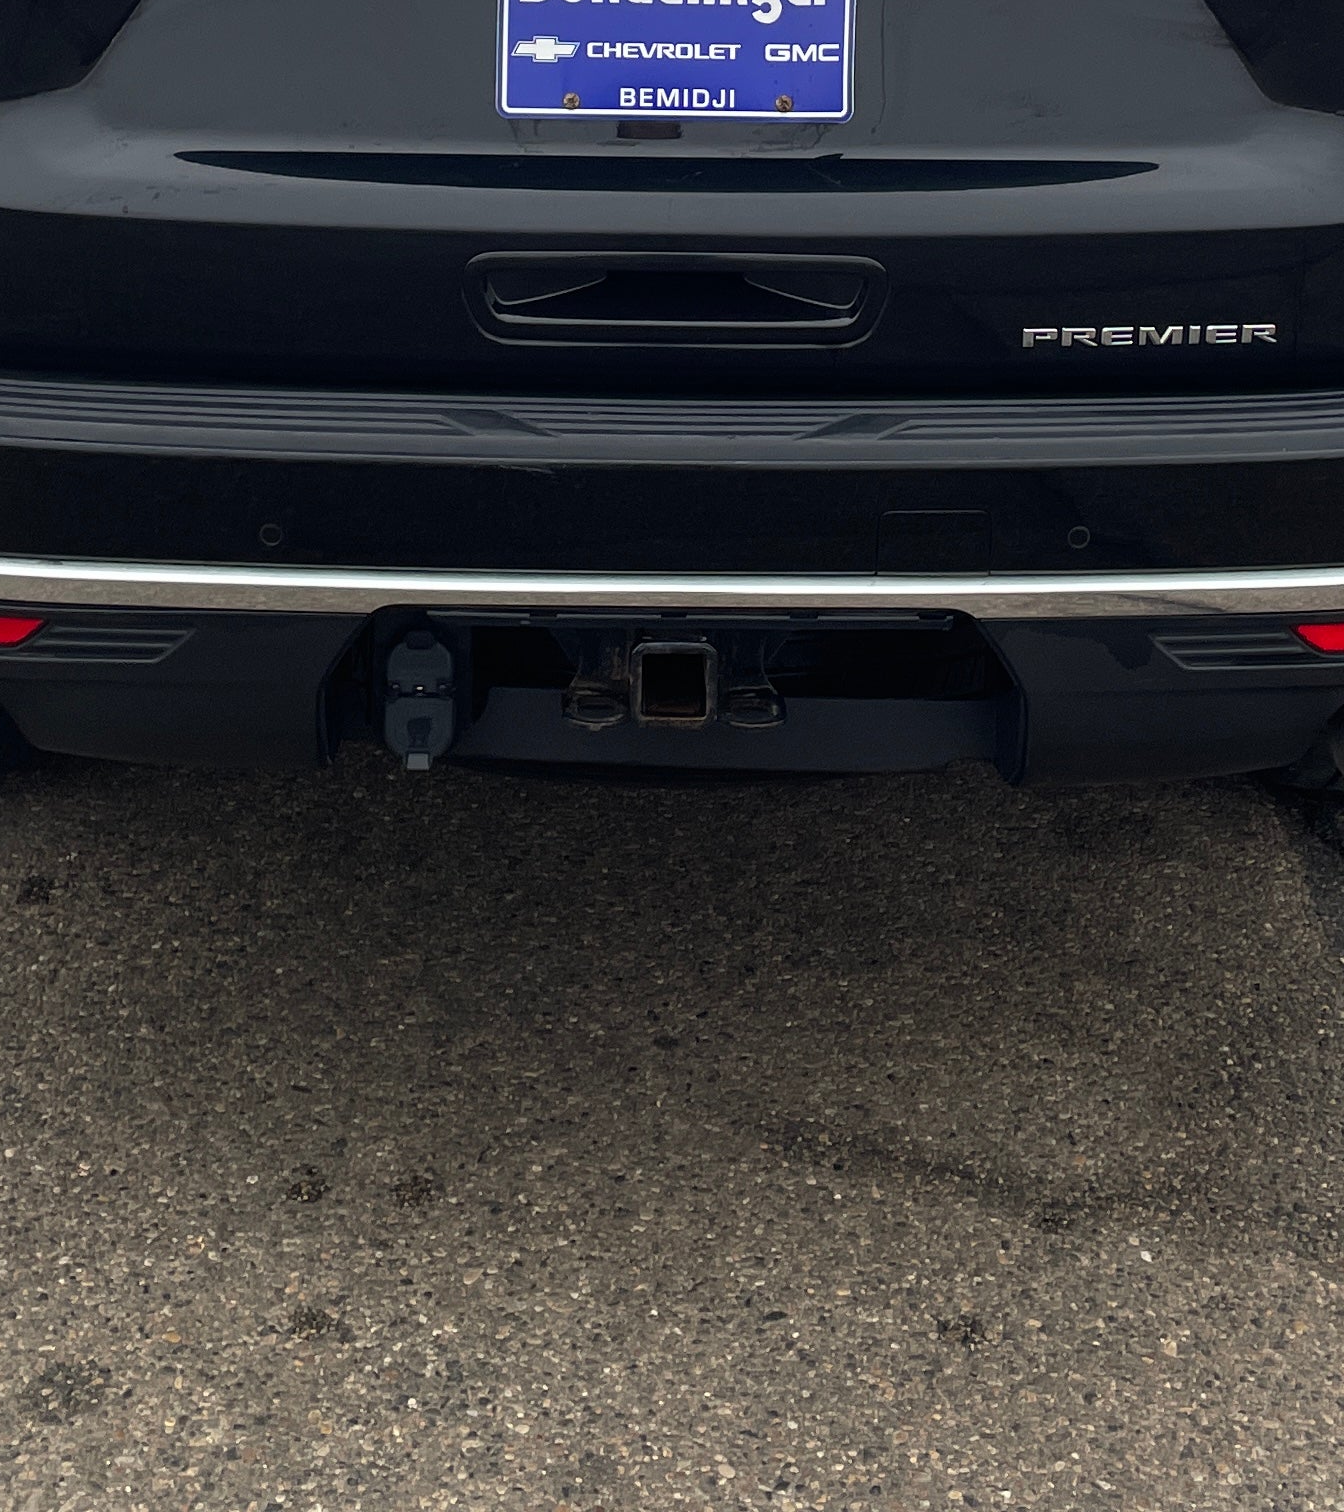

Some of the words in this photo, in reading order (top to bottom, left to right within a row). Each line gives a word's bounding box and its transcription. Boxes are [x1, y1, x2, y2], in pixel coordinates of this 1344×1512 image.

[586, 42, 742, 60] CHEVROLET
[765, 44, 840, 62] GMC
[619, 88, 735, 108] BEMIDJI
[1022, 324, 1277, 347] PREMIER
